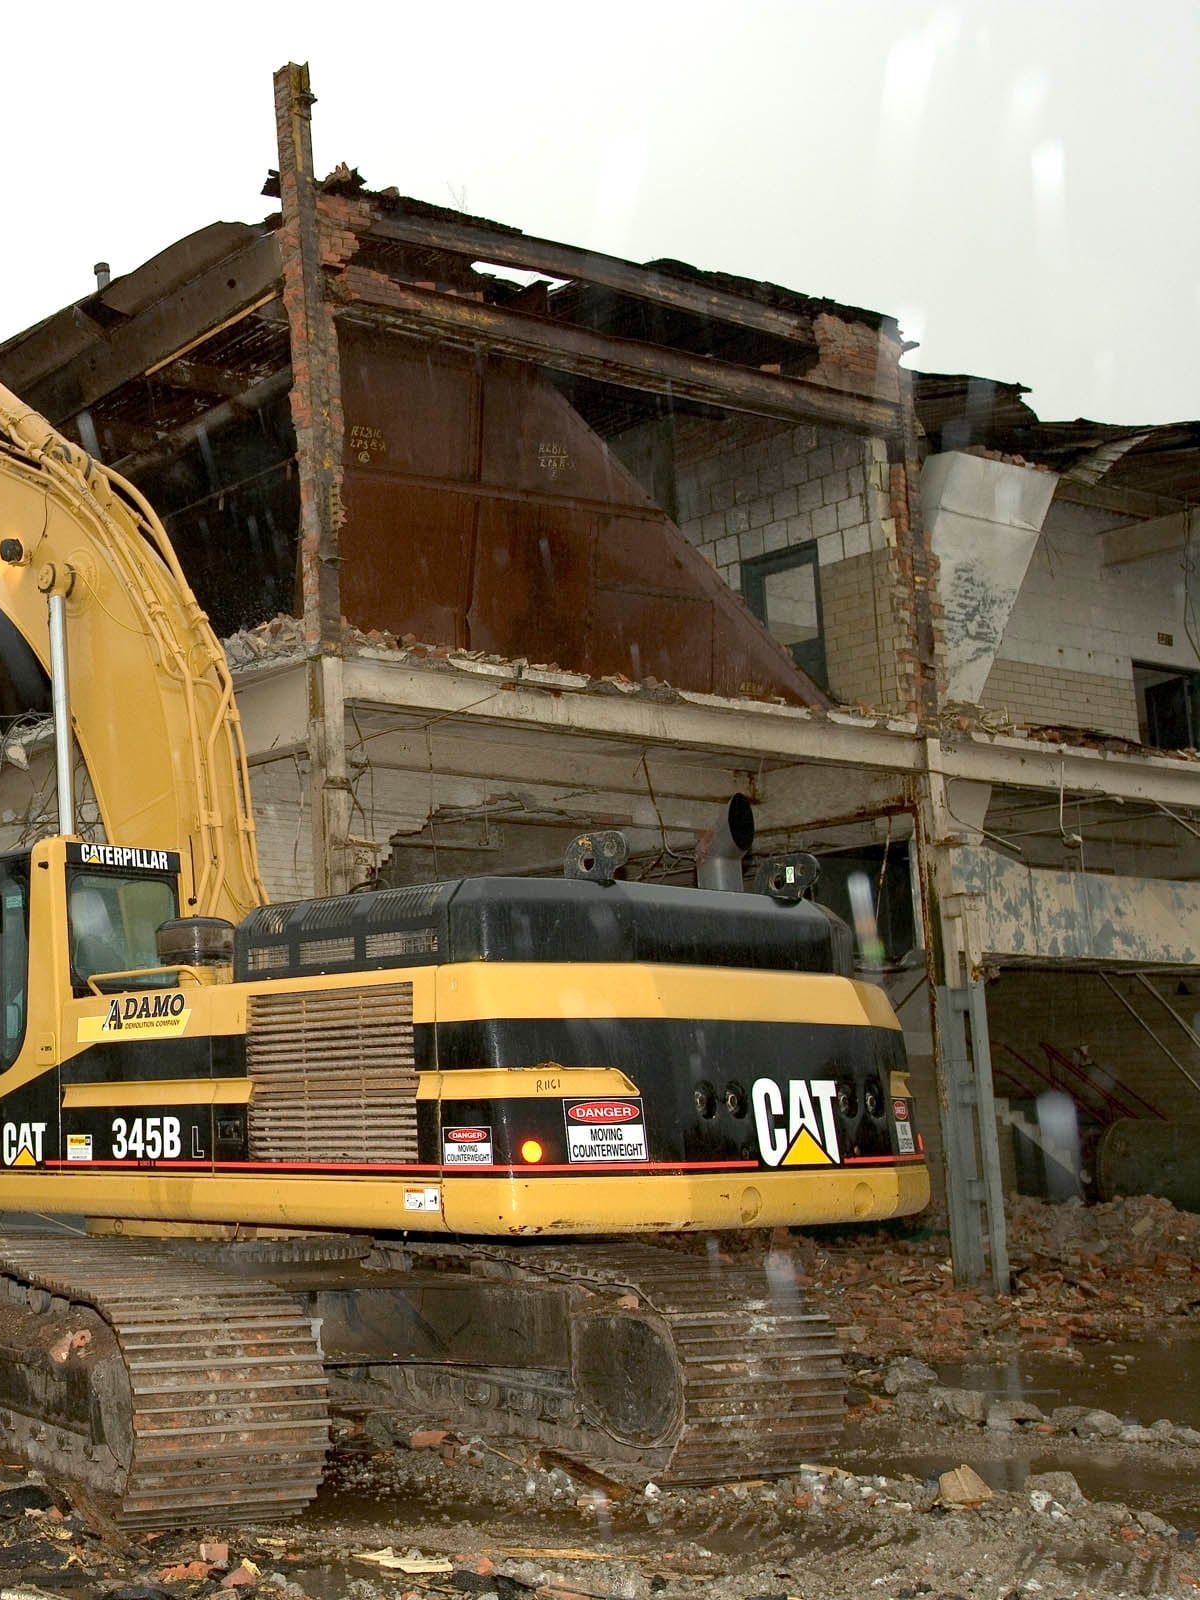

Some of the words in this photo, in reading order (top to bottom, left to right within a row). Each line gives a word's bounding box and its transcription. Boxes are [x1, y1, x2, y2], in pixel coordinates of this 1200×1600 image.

[80, 844, 169, 870] CATERPILLAR
[102, 993, 185, 1031] ADAMO
[124, 1021, 155, 1030] DEMOLITION
[155, 1019, 181, 1028] COMPANY
[575, 1107, 632, 1118] DANGER
[751, 1077, 841, 1167] CAT
[112, 1116, 182, 1159] 345B
[191, 1125, 205, 1159] L
[590, 1127, 623, 1142] MOVING
[3, 1121, 47, 1166] CAT
[457, 1144, 478, 1152] MOVING
[572, 1143, 643, 1158] COUNTERWEIGHT
[446, 1153, 490, 1162] COUNTERWEIGHT
